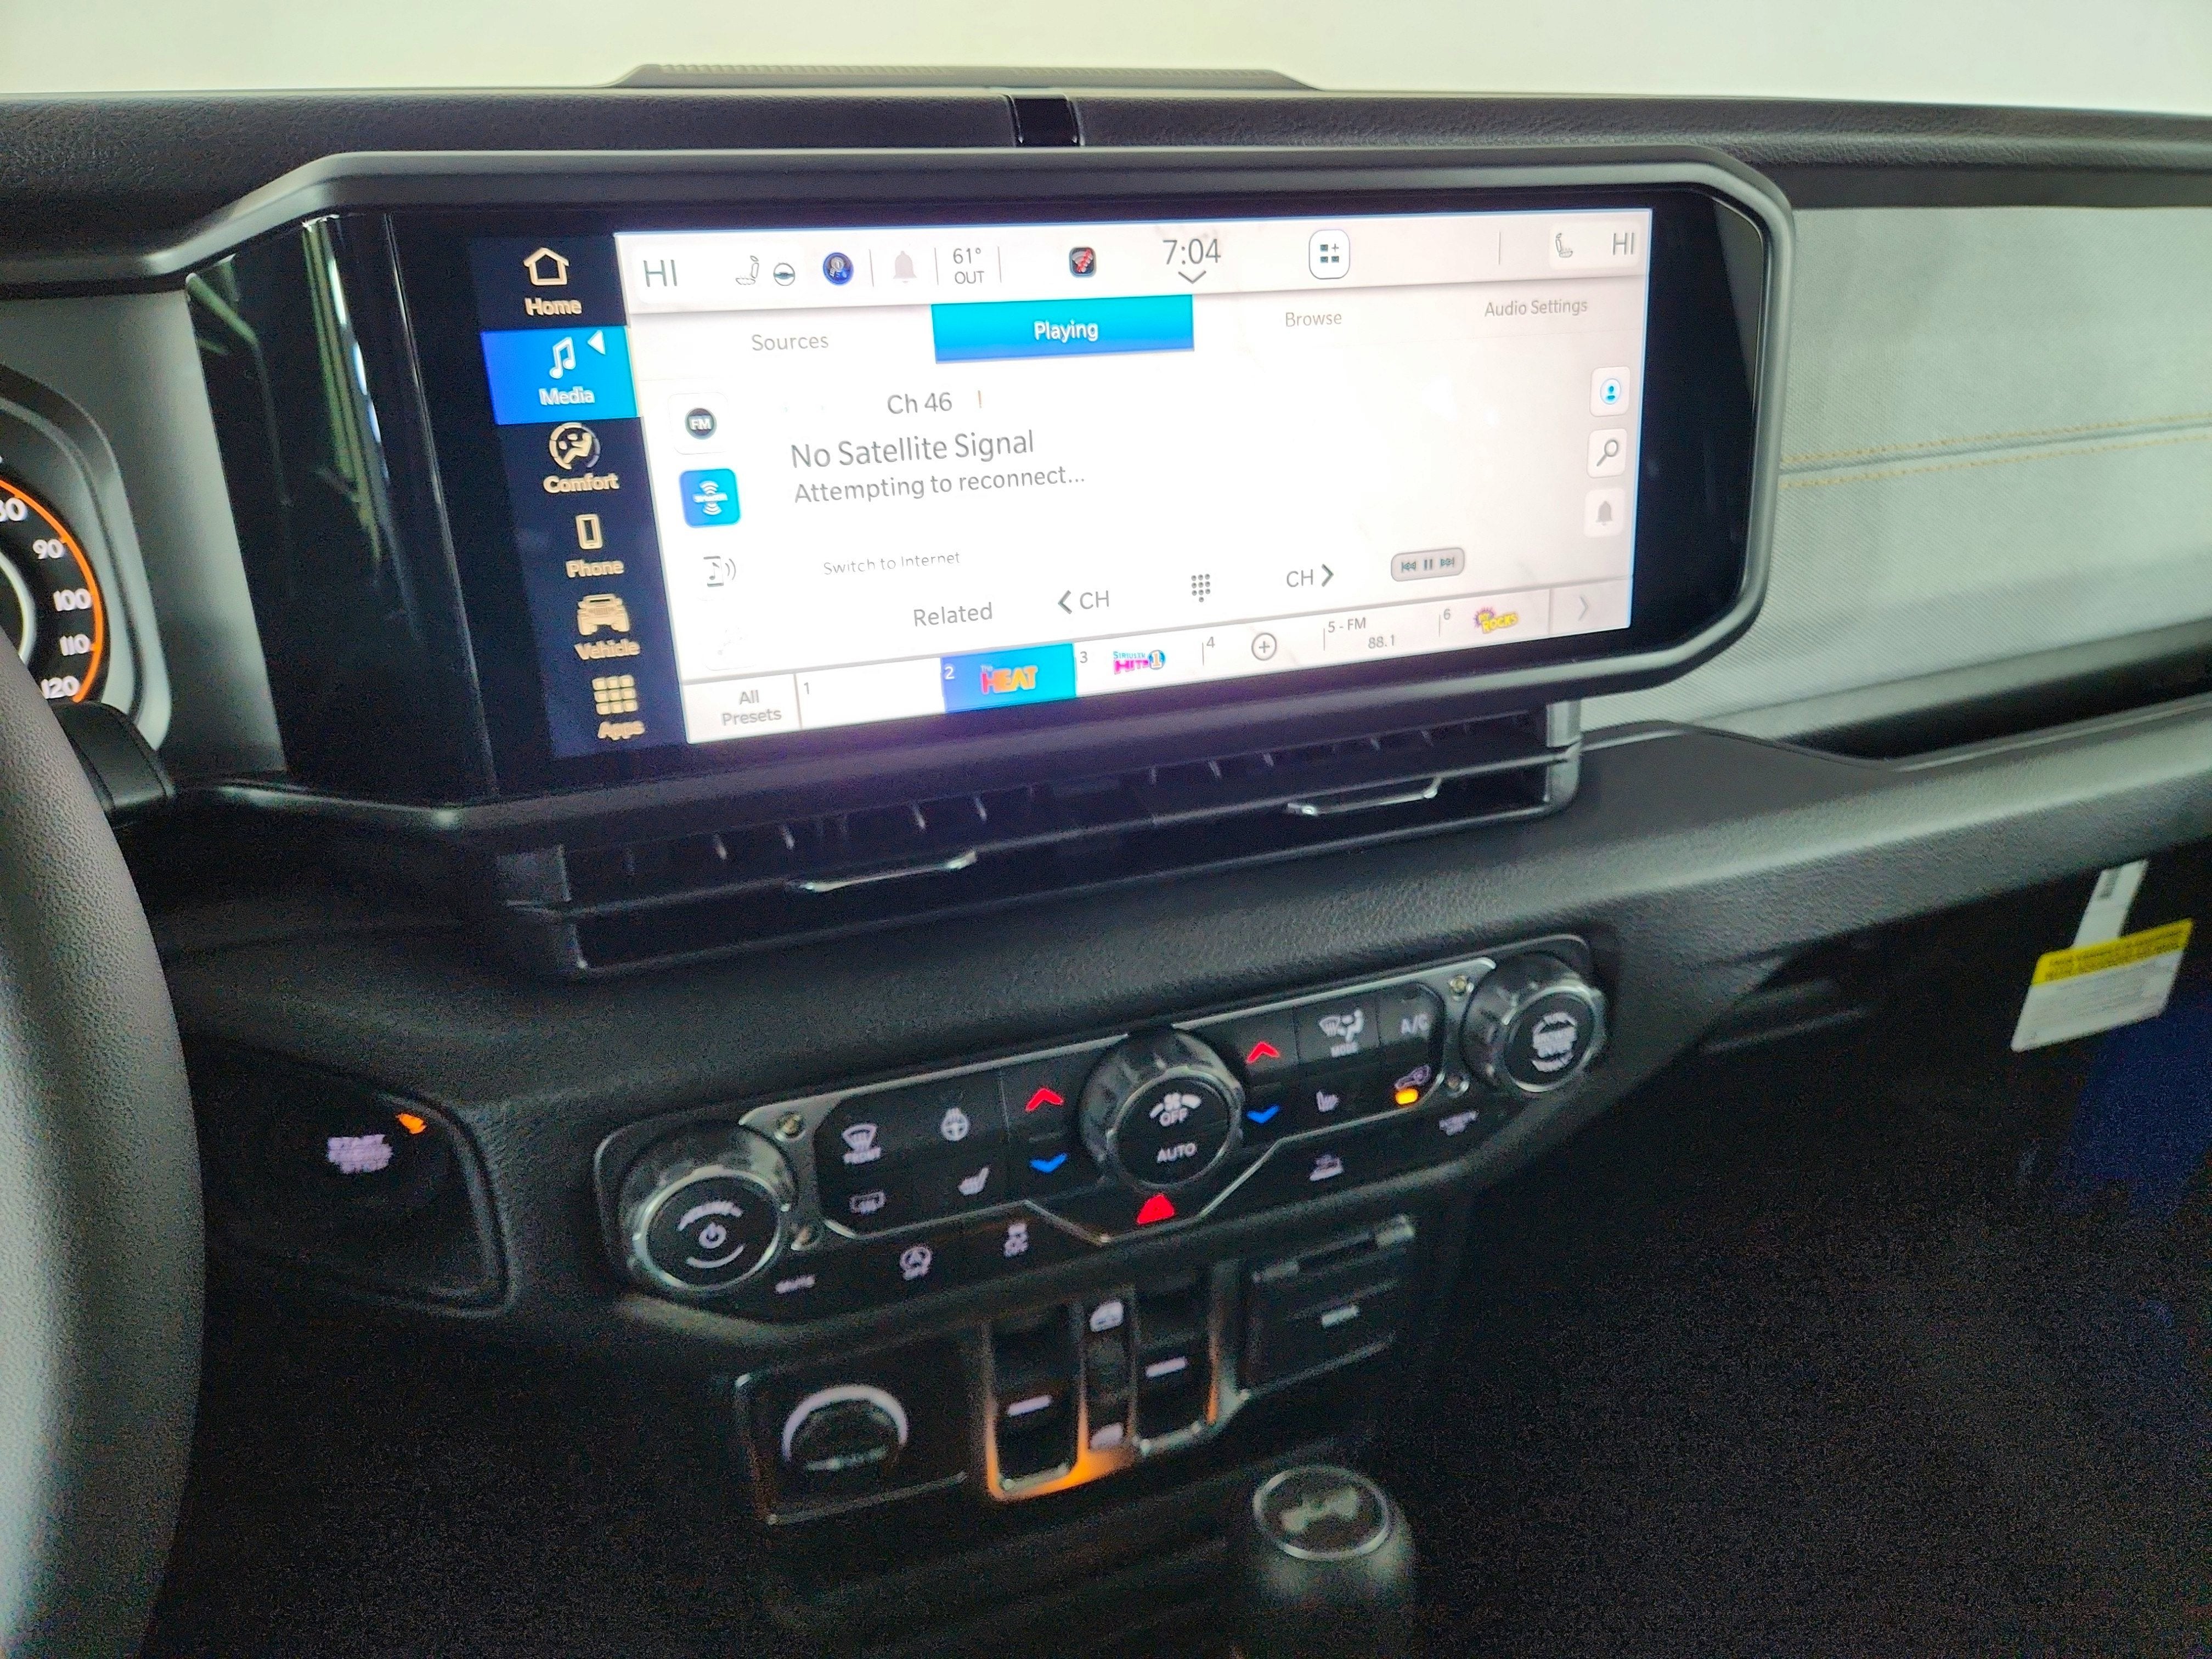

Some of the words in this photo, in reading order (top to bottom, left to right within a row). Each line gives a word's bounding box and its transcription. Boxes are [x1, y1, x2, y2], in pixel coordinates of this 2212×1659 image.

[1162, 238, 1222, 264] 7:04
[1612, 233, 1635, 256] HI
[643, 259, 678, 287] HI
[955, 271, 985, 284] OUT
[524, 298, 583, 316] Home
[1485, 301, 1527, 317] Audio
[1531, 298, 1588, 316] Settings
[1285, 311, 1342, 328] Browse
[1034, 319, 1099, 342] Playing
[751, 334, 829, 352] Sources
[539, 386, 596, 406] Media
[887, 395, 918, 415] Ch
[924, 392, 953, 413] 46
[690, 416, 712, 431] FM
[791, 443, 831, 468] No
[838, 436, 947, 466] Satellite
[954, 430, 1034, 462] Signal
[543, 473, 620, 494] Comfort
[794, 477, 925, 503] Attempting
[931, 475, 952, 494] to
[959, 465, 1085, 492] reconnect...
[32, 539, 65, 559] 90
[565, 559, 624, 578] Phone
[824, 559, 875, 575] Switch
[881, 558, 896, 570] to
[901, 552, 961, 567] Internet
[1286, 569, 1314, 588] CH
[53, 588, 92, 611] 100
[1079, 590, 1110, 610] CH
[913, 602, 993, 627] Related
[1443, 608, 1451, 620] 6
[1328, 620, 1335, 634] 5
[1347, 618, 1367, 631] FM
[59, 634, 91, 656] 110
[574, 639, 641, 660] Vehicle
[1207, 636, 1215, 649] 4
[1368, 635, 1396, 649] 88.1
[1080, 651, 1088, 664] 3
[945, 666, 955, 680] 2
[980, 664, 1039, 695] HEAT
[41, 676, 81, 699] 120
[804, 682, 810, 695] 1
[739, 690, 759, 706] All
[722, 708, 782, 727] Presets
[598, 720, 646, 741] Apps
[1160, 1108, 1189, 1127] OFF
[1156, 1142, 1197, 1164] AUTO
